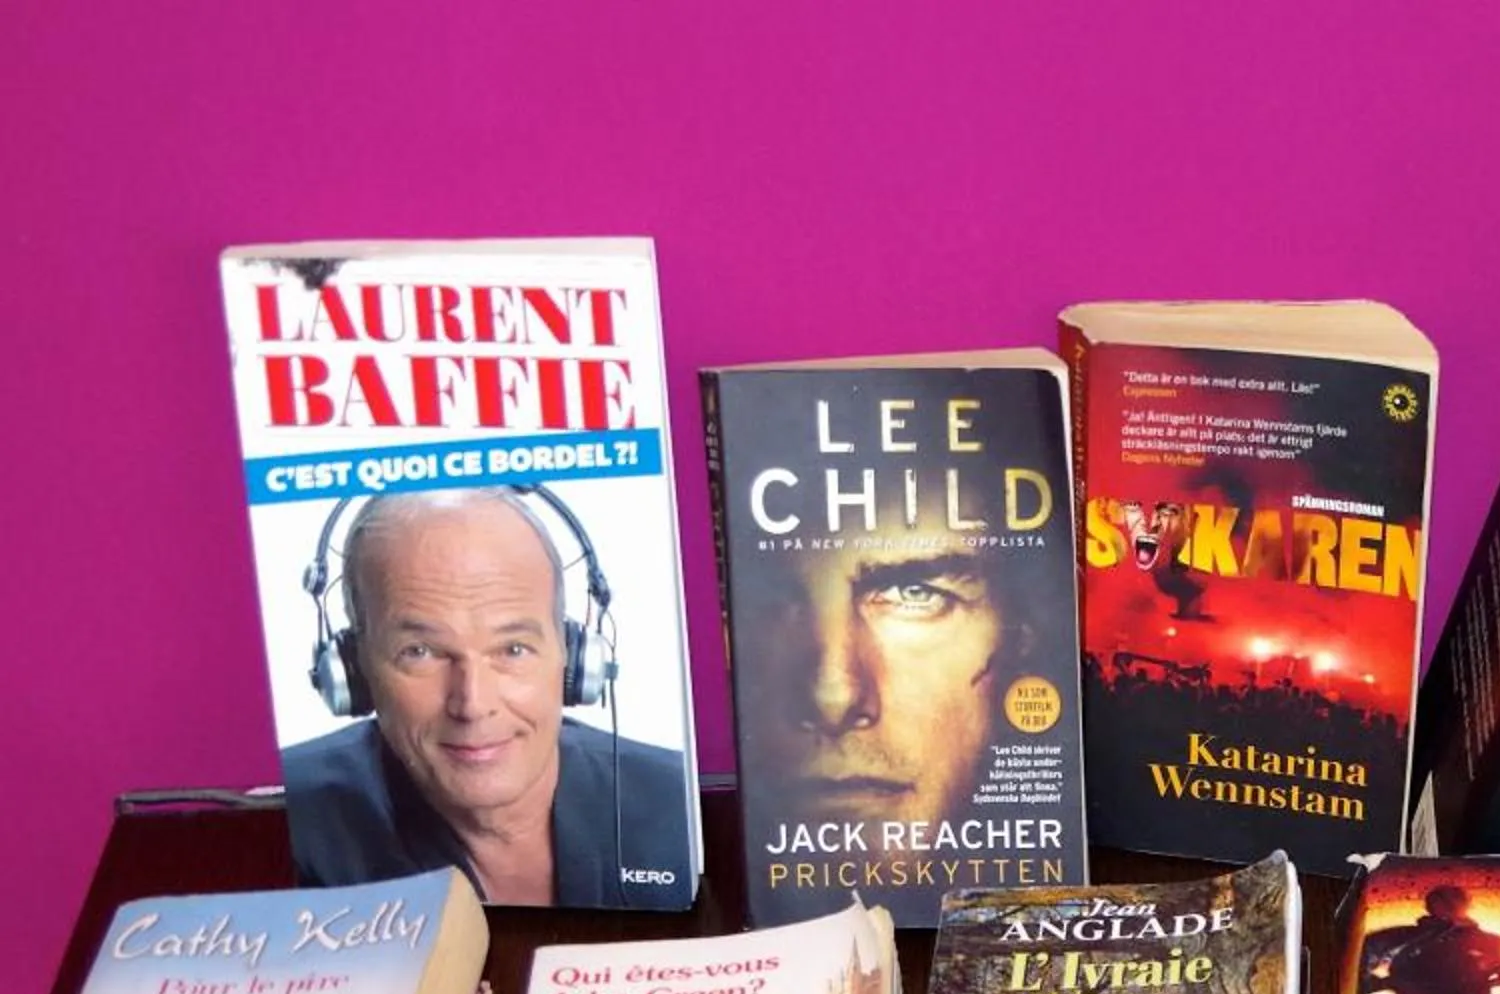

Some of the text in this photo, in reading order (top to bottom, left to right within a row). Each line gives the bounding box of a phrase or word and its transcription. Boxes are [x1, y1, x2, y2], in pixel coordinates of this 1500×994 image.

[254, 283, 628, 347] LAURENT
[262, 354, 636, 430] BAFFIE
[817, 400, 985, 452] LEE
[357, 456, 437, 489] QUOI
[443, 452, 482, 477] CE
[488, 445, 607, 471] BORDEL
[750, 467, 1054, 534] CHILD
[1187, 733, 1368, 787] Katarina
[1148, 764, 1364, 821] Wennstam
[767, 819, 1062, 854] JACK REACHER
[620, 867, 675, 884] KERO
[770, 859, 1063, 888] PRICKSKYTTEN
[1000, 907, 1234, 942] ANGLADE
[1083, 898, 1158, 918] Jean
[113, 898, 429, 965] Cathy Kelly
[248, 974, 273, 994] le
[551, 955, 781, 987] Qui êtes-vous
[1062, 949, 1213, 990] Ivraie
